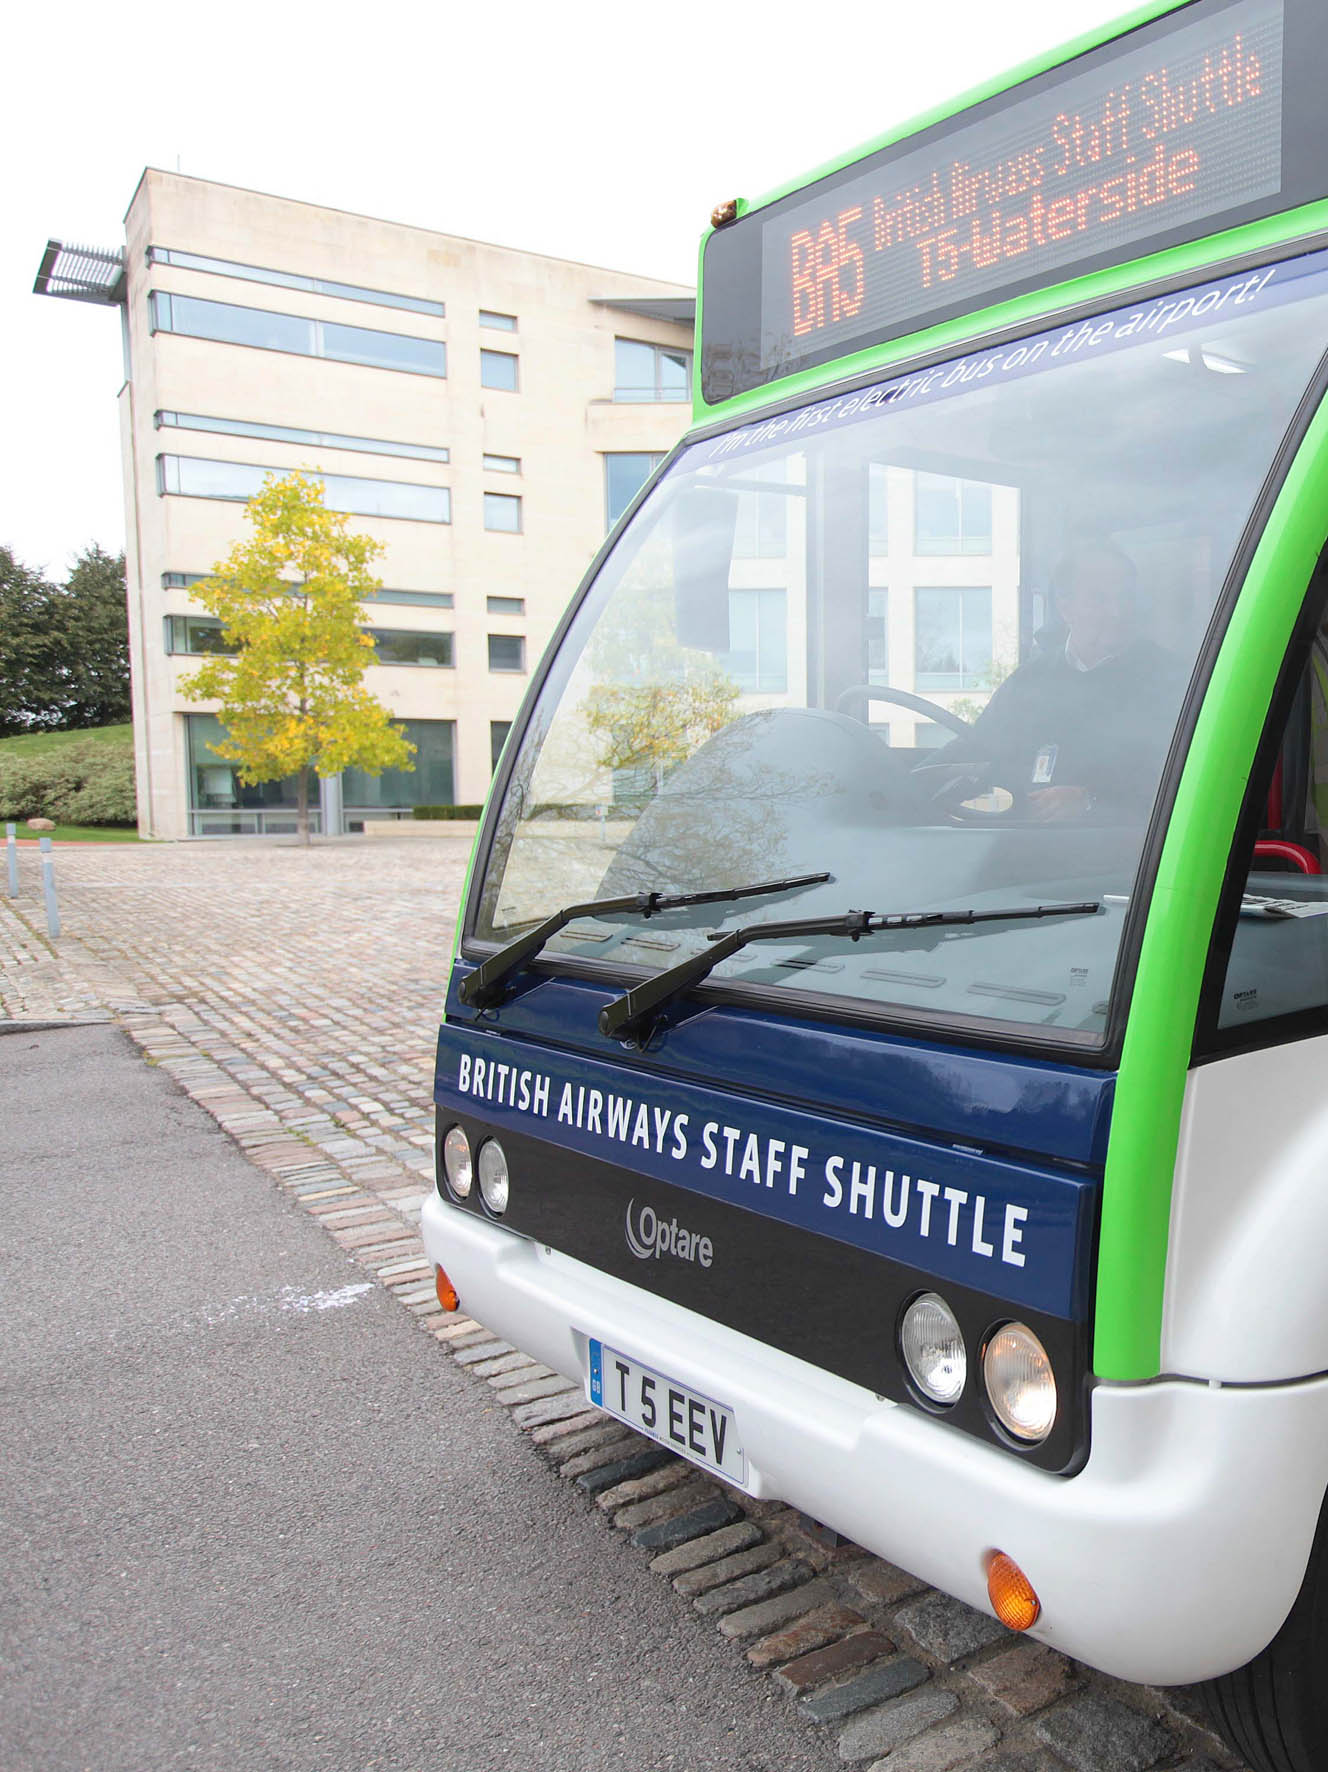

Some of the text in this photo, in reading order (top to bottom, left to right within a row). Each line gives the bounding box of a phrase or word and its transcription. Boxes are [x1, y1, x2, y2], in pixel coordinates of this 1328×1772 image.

[873, 34, 1261, 251] British Airways Staff Shuttle
[749, 418, 786, 446] the
[784, 400, 842, 435] first
[838, 369, 942, 419] electric
[941, 353, 1002, 388] bus
[1002, 339, 1049, 371] on
[1051, 320, 1112, 357] the
[1114, 269, 1277, 339] airport!
[458, 1053, 1029, 1268] BRITISH AIRWAYS STAFF SHUTTLE
[637, 1204, 713, 1268] Optare
[669, 1388, 727, 1466] EEV
